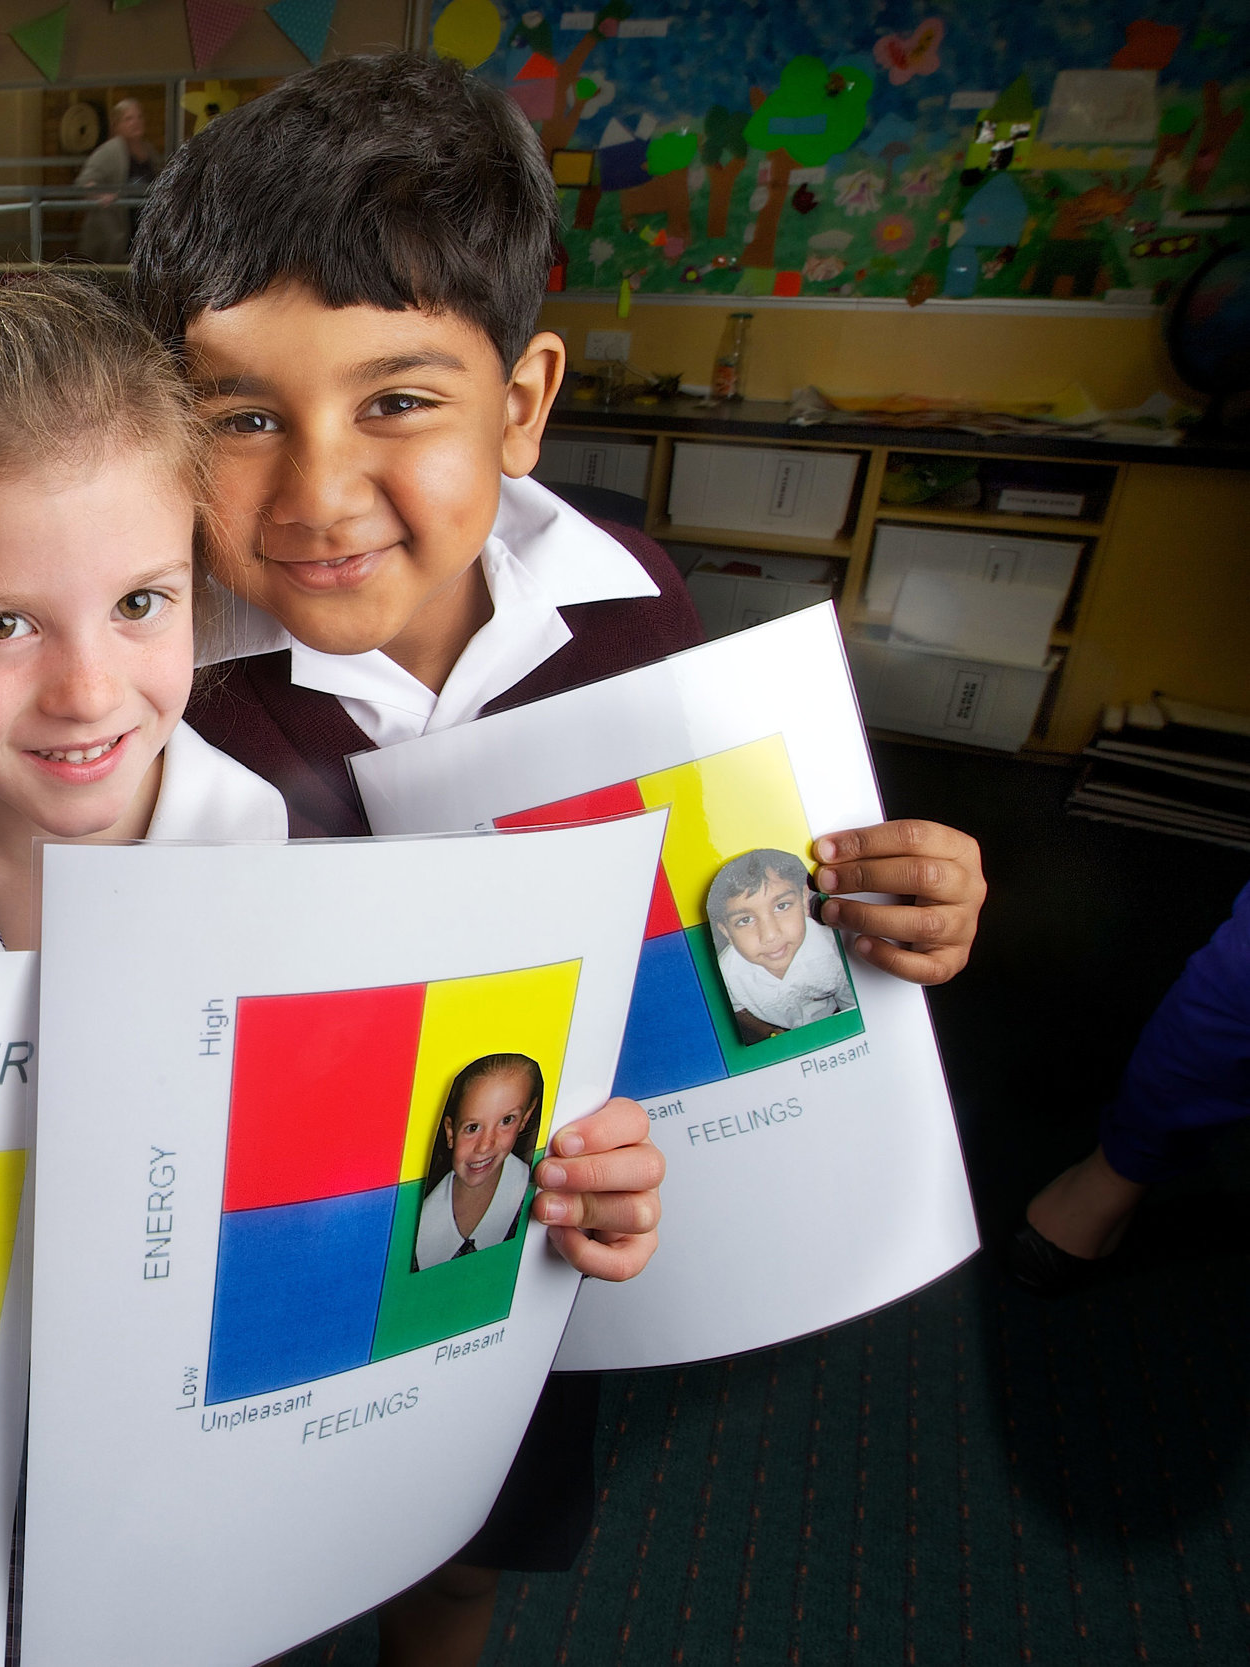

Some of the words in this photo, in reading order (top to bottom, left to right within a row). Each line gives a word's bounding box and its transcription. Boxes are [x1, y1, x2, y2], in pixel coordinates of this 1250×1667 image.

[199, 998, 229, 1056] High
[800, 1040, 871, 1079] Pleasant
[646, 1099, 686, 1122] sant
[687, 1097, 804, 1147] FEELINGS
[144, 1145, 177, 1280] ENERGY
[435, 1327, 506, 1366] Pleasant
[176, 1365, 199, 1411] Low
[201, 1389, 313, 1432] Unpleasant
[301, 1386, 420, 1445] FEELINGS
